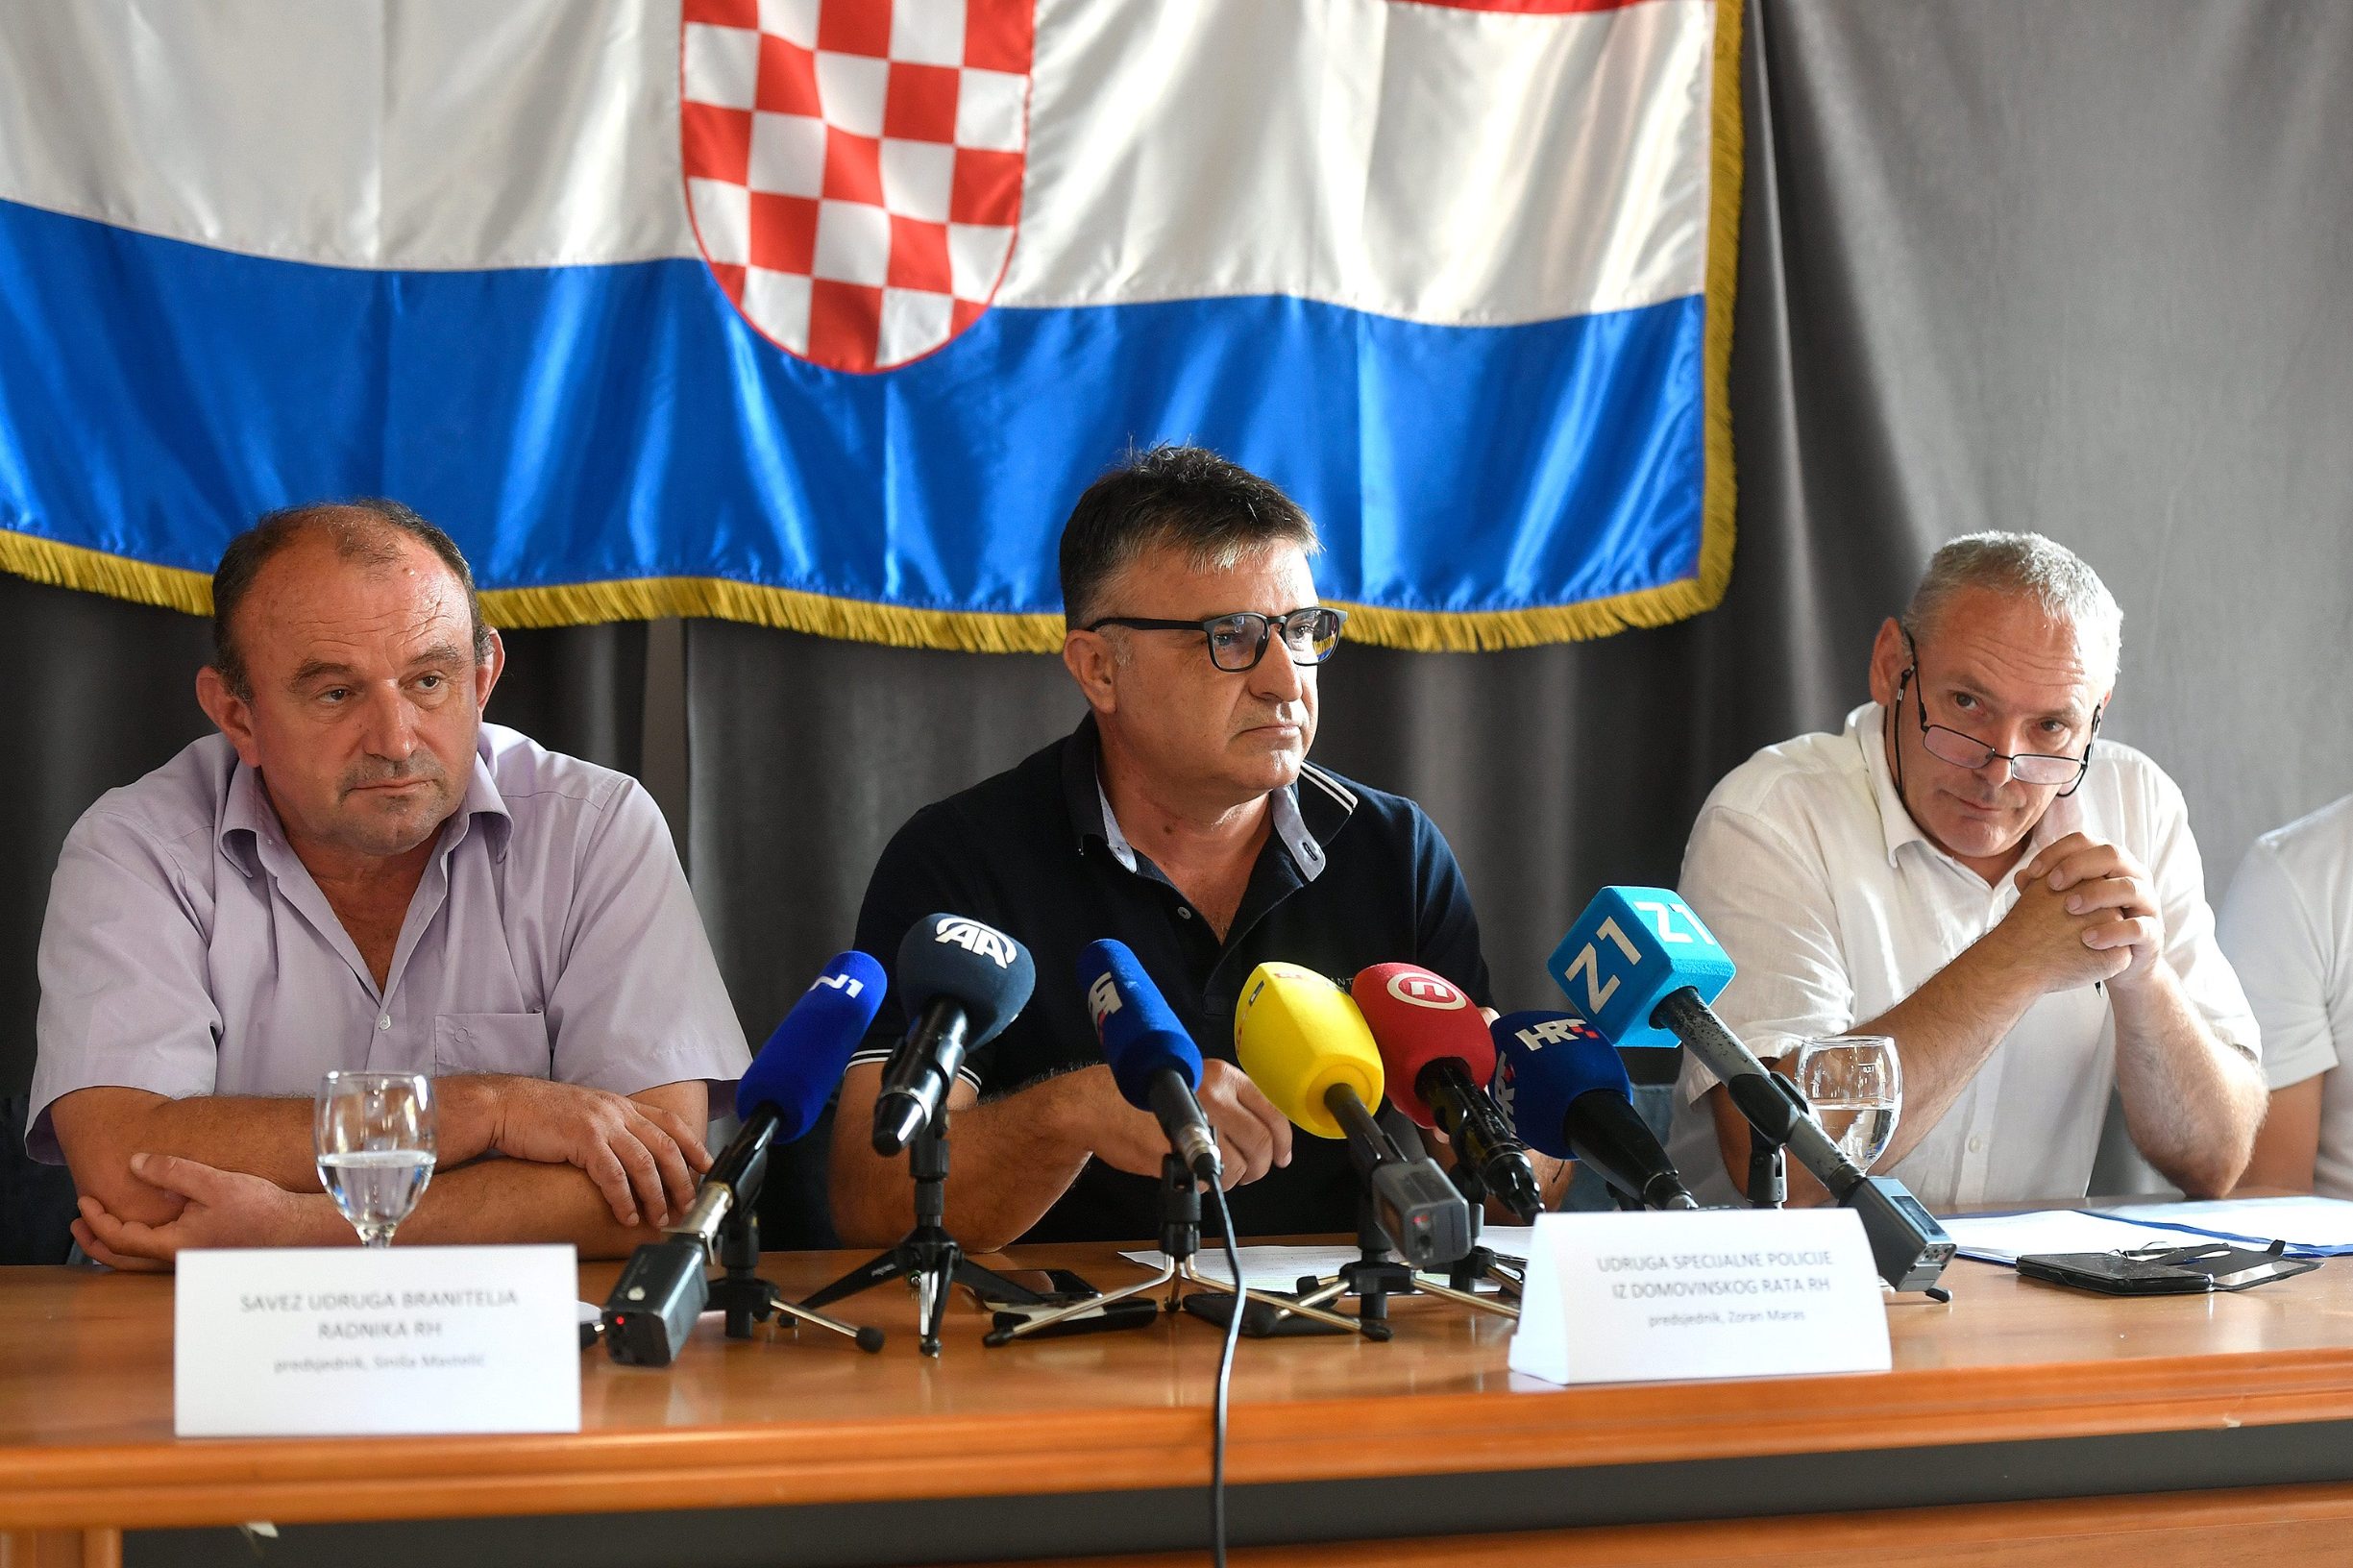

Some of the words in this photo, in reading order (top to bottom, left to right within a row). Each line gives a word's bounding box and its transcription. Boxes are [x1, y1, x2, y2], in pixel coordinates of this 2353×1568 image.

[1633, 901, 1715, 945] Z1
[1564, 916, 1642, 1015] Z1
[1597, 1255, 1669, 1273] UDRUGA
[1673, 1252, 1763, 1269] SPECIJALNE
[1768, 1250, 1832, 1266] POLICIJE
[1612, 1284, 1627, 1299] IZ
[1631, 1280, 1757, 1299] DOMOVINSKOG
[1762, 1278, 1804, 1293] RATA
[1808, 1276, 1830, 1291] RH
[240, 1290, 303, 1312] SAVEZ
[308, 1290, 395, 1311] UDRUGA
[318, 1320, 407, 1340] RADNIKA
[414, 1320, 442, 1337] RH
